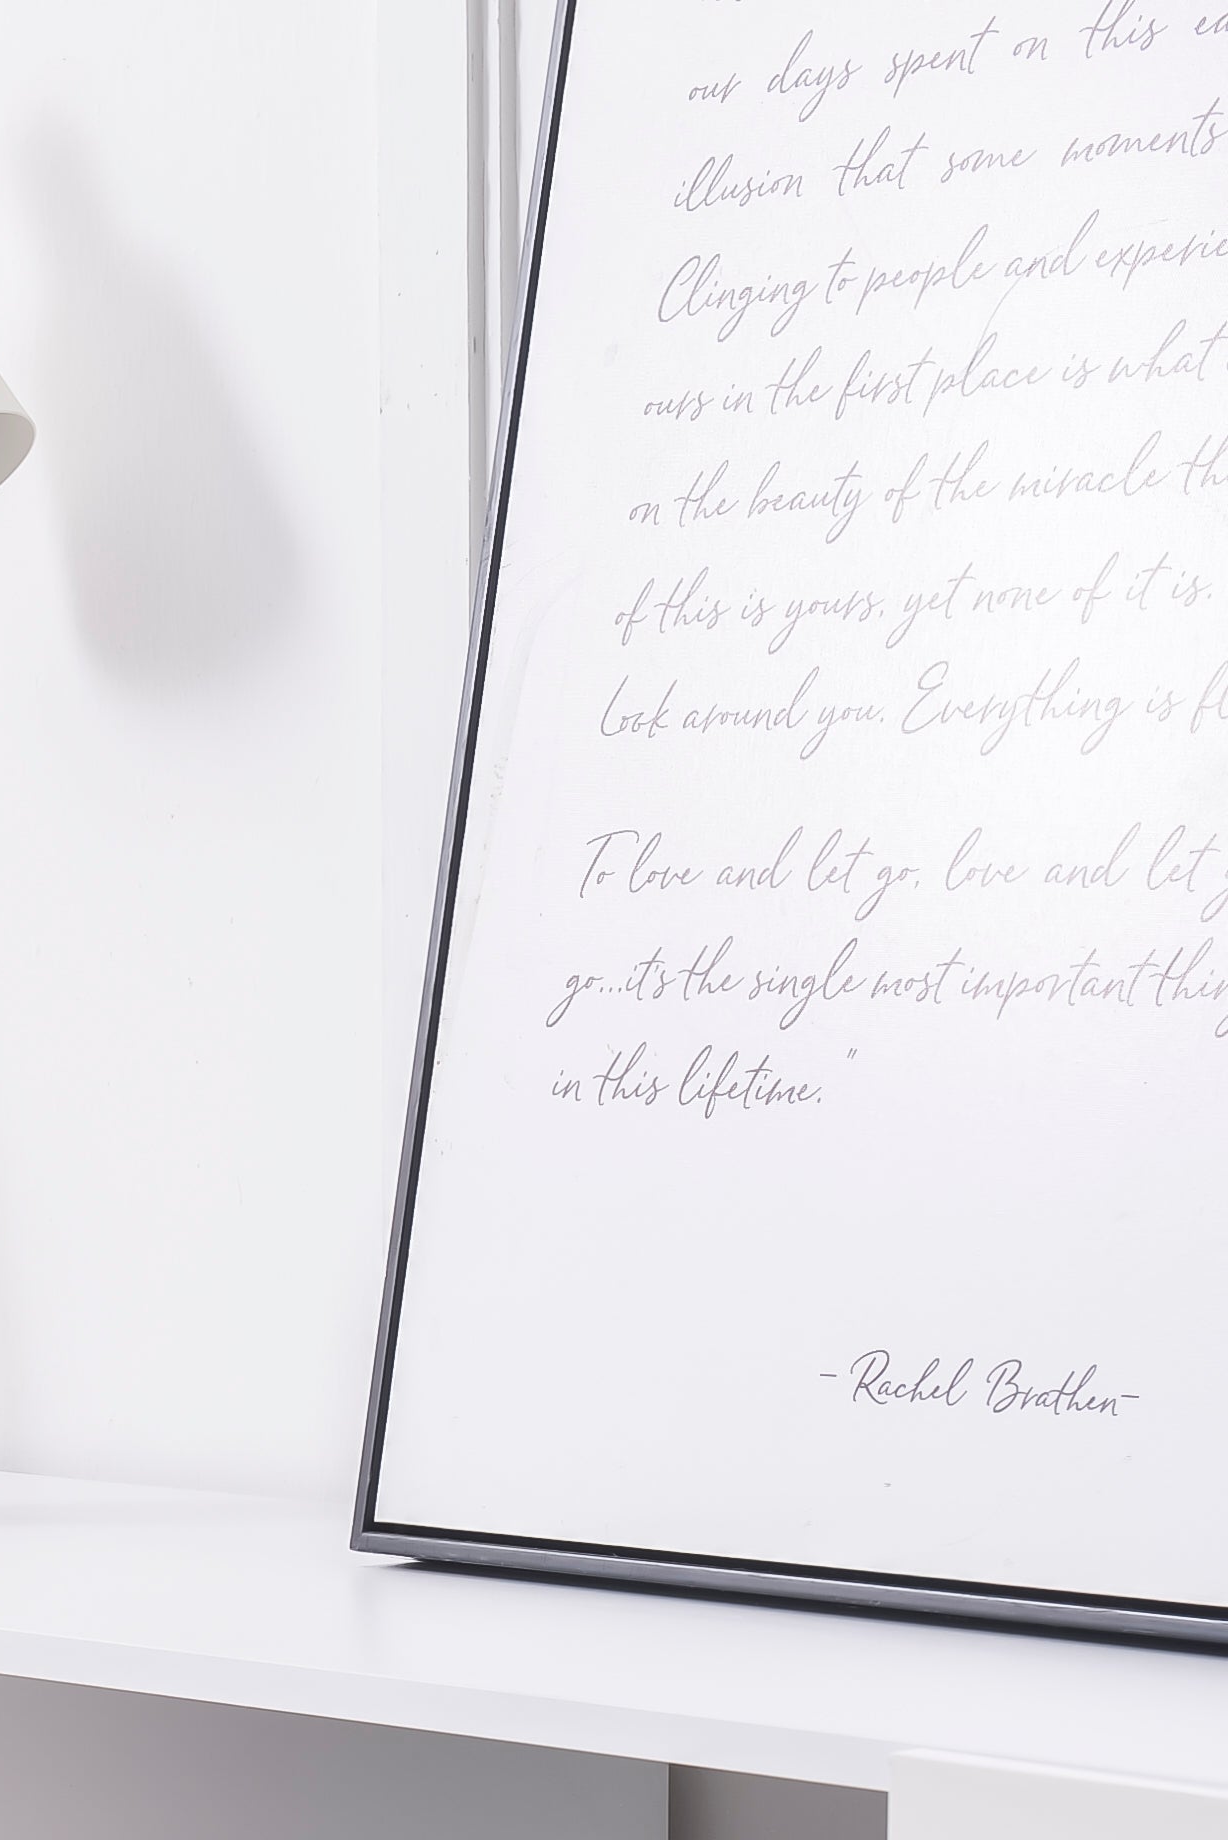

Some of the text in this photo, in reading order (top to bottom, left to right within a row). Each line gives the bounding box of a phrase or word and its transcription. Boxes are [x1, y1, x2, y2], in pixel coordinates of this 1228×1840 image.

[689, 73, 742, 103] our
[767, 29, 863, 122] days
[884, 16, 999, 99] spent
[1013, 36, 1047, 60] on
[1078, 0, 1168, 59] this
[674, 97, 1228, 211] illusion that some moments
[658, 252, 819, 343] Clinging
[826, 246, 864, 305] to
[857, 224, 997, 315] people
[1004, 209, 1101, 279] and
[644, 319, 1228, 421] ours in the first place is what
[629, 503, 659, 526] on
[674, 460, 739, 528] the
[748, 460, 873, 545] beauty
[884, 453, 929, 523] of
[929, 440, 1001, 510] the
[1009, 430, 1170, 501] miracle
[615, 552, 1214, 655] of this is yours, yet none of it is.
[601, 674, 677, 738] Look
[683, 665, 819, 733] around
[800, 705, 885, 761] you.
[901, 660, 1135, 757] Everything
[1146, 685, 1183, 722] is
[580, 822, 1220, 922] To love and let go, love and let
[677, 936, 747, 1001] the
[749, 938, 869, 1030] single
[871, 946, 967, 1004] most
[960, 947, 1160, 1020] important
[552, 1070, 581, 1101] in
[592, 1040, 673, 1106] this
